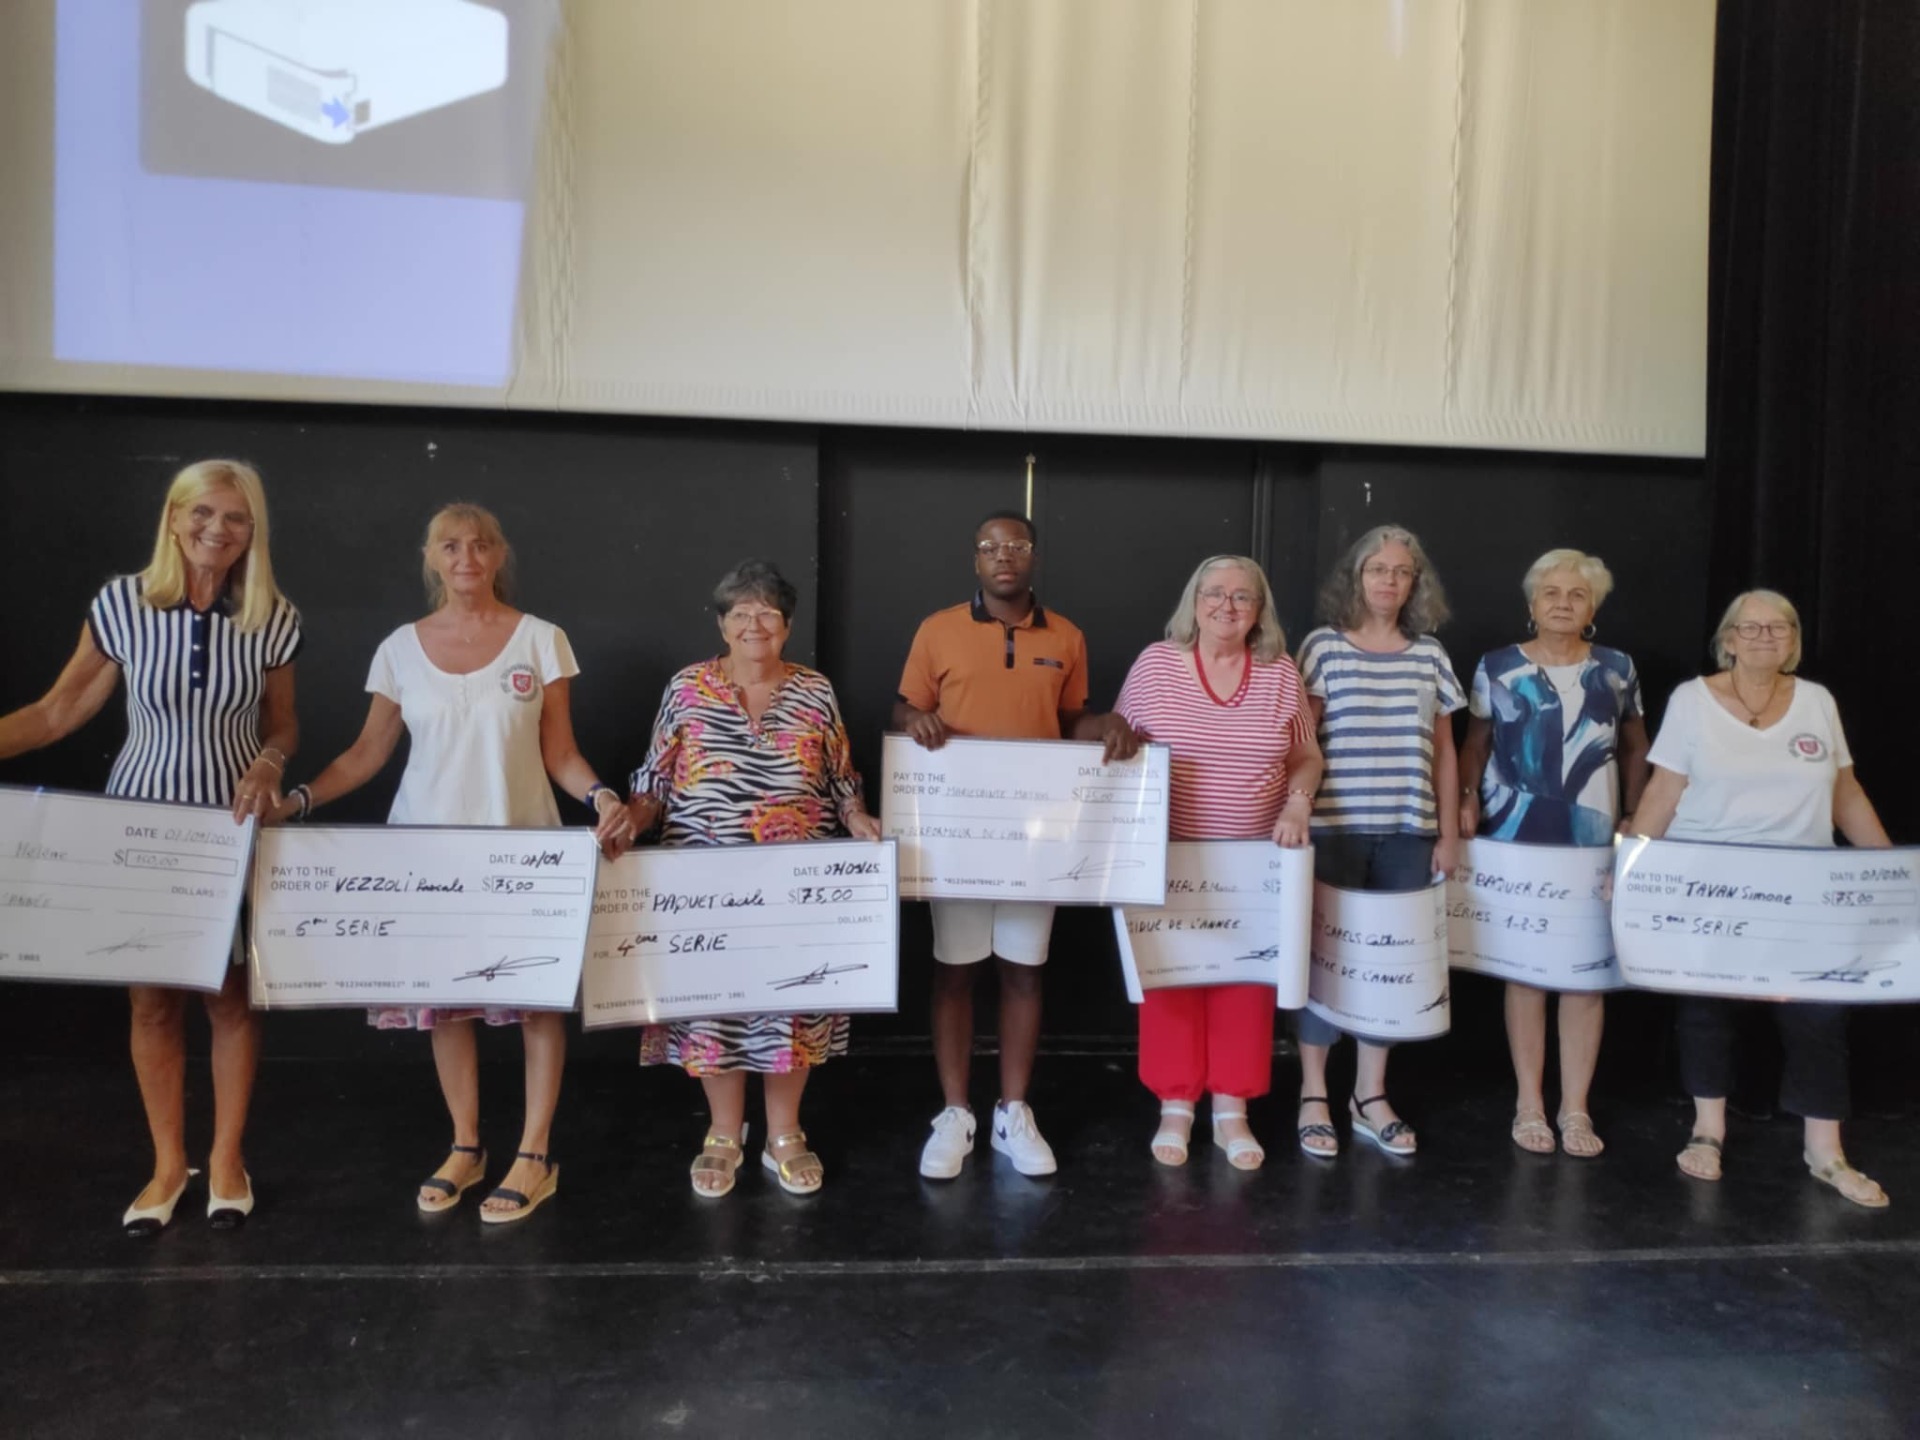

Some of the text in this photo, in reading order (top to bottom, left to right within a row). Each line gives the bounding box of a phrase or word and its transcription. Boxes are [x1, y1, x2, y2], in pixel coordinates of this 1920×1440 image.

[893, 772, 946, 783] PAY TO THE
[1078, 767, 1101, 777] DATE
[893, 785, 941, 796] ORDER OF
[125, 826, 158, 840] DATE
[489, 854, 517, 865] DATE
[271, 867, 336, 877] PAY TO THE
[793, 866, 820, 877] DATE
[1829, 871, 1855, 881] DATE
[1628, 872, 1684, 884] PAY TO THE
[271, 880, 330, 891] ORDER OF
[1627, 884, 1679, 895] ORDER OF
[171, 885, 215, 898] DOLLARS
[593, 888, 651, 900] PAY TO THE
[1685, 880, 1793, 906] TAVAN Simone
[592, 903, 646, 915] ORDER OF
[652, 892, 720, 915] PAQUET
[531, 908, 567, 918] DOLLARS
[838, 915, 873, 924] DOLLARS
[268, 929, 286, 937] FOR
[593, 950, 609, 959] FOR
